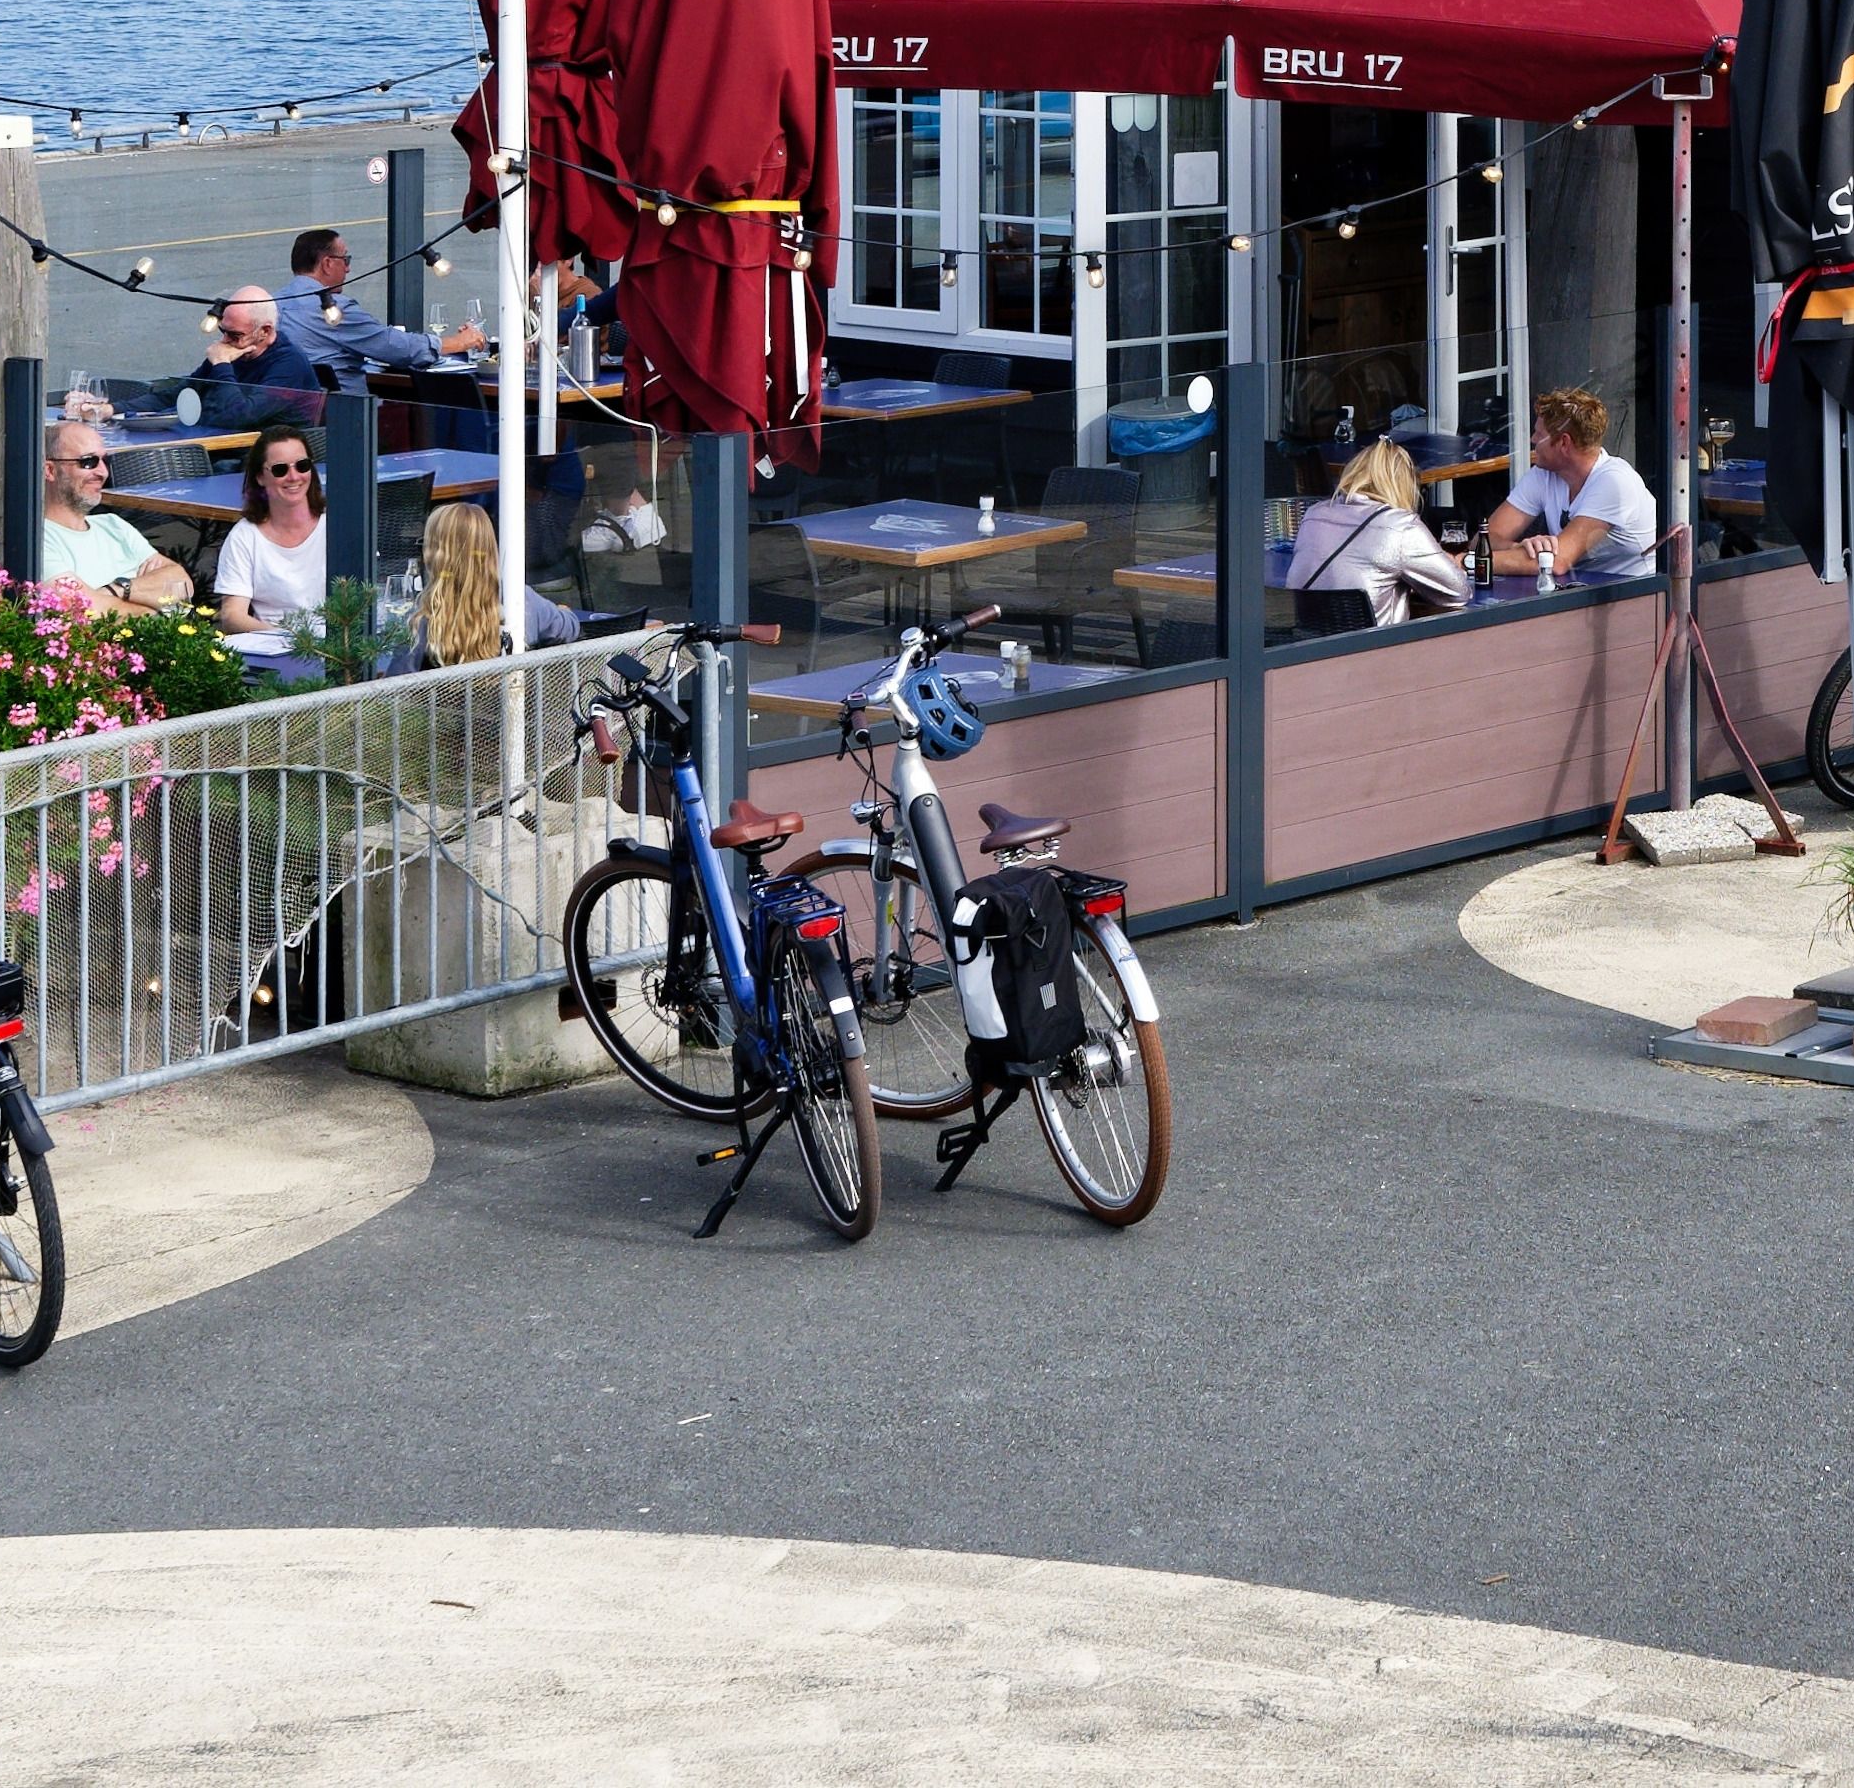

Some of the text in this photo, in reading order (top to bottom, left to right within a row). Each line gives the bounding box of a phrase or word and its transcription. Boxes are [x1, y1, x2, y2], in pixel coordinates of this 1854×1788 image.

[831, 36, 929, 63] RU 17
[1263, 47, 1404, 82] BRU 17
